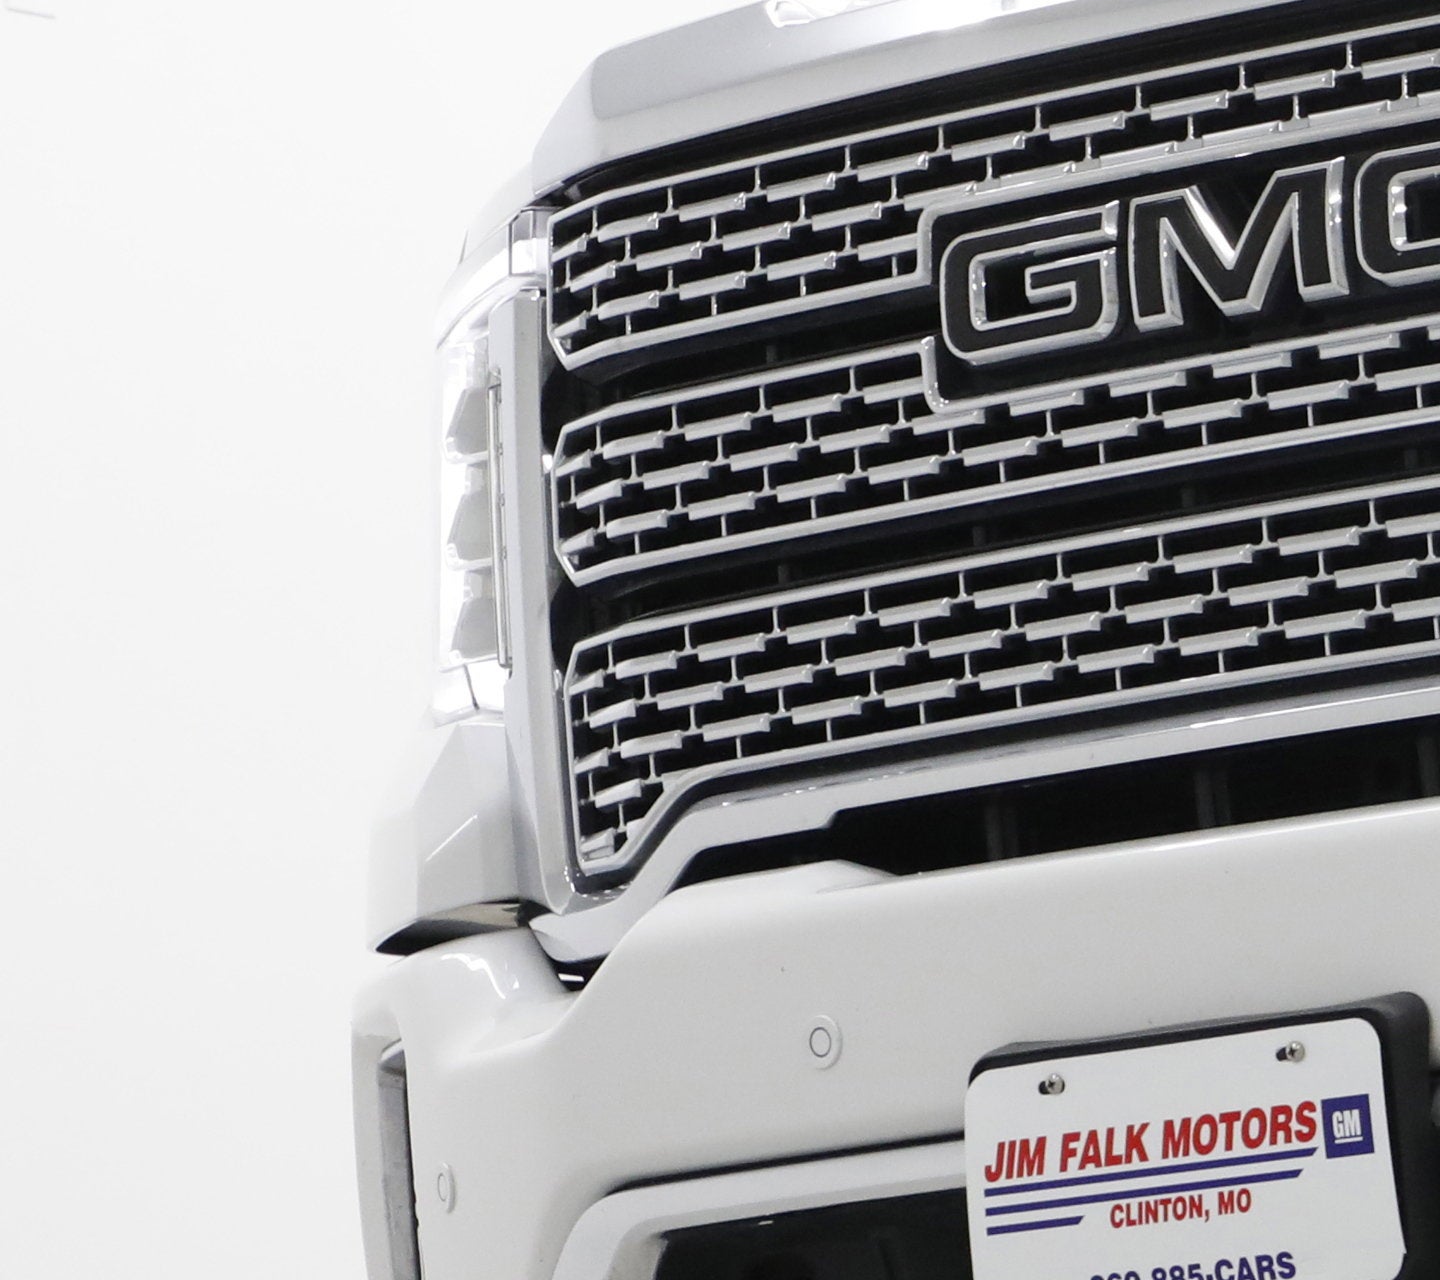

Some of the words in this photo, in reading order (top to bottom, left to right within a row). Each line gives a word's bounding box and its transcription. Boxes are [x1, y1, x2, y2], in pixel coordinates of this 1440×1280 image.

[984, 1138, 1047, 1183] JIM
[1060, 1123, 1149, 1172] FALK
[1161, 1100, 1317, 1159] MOTORS
[1332, 1108, 1362, 1141] GM
[1110, 1194, 1209, 1228] CLINTON,
[1218, 1188, 1252, 1215] MO
